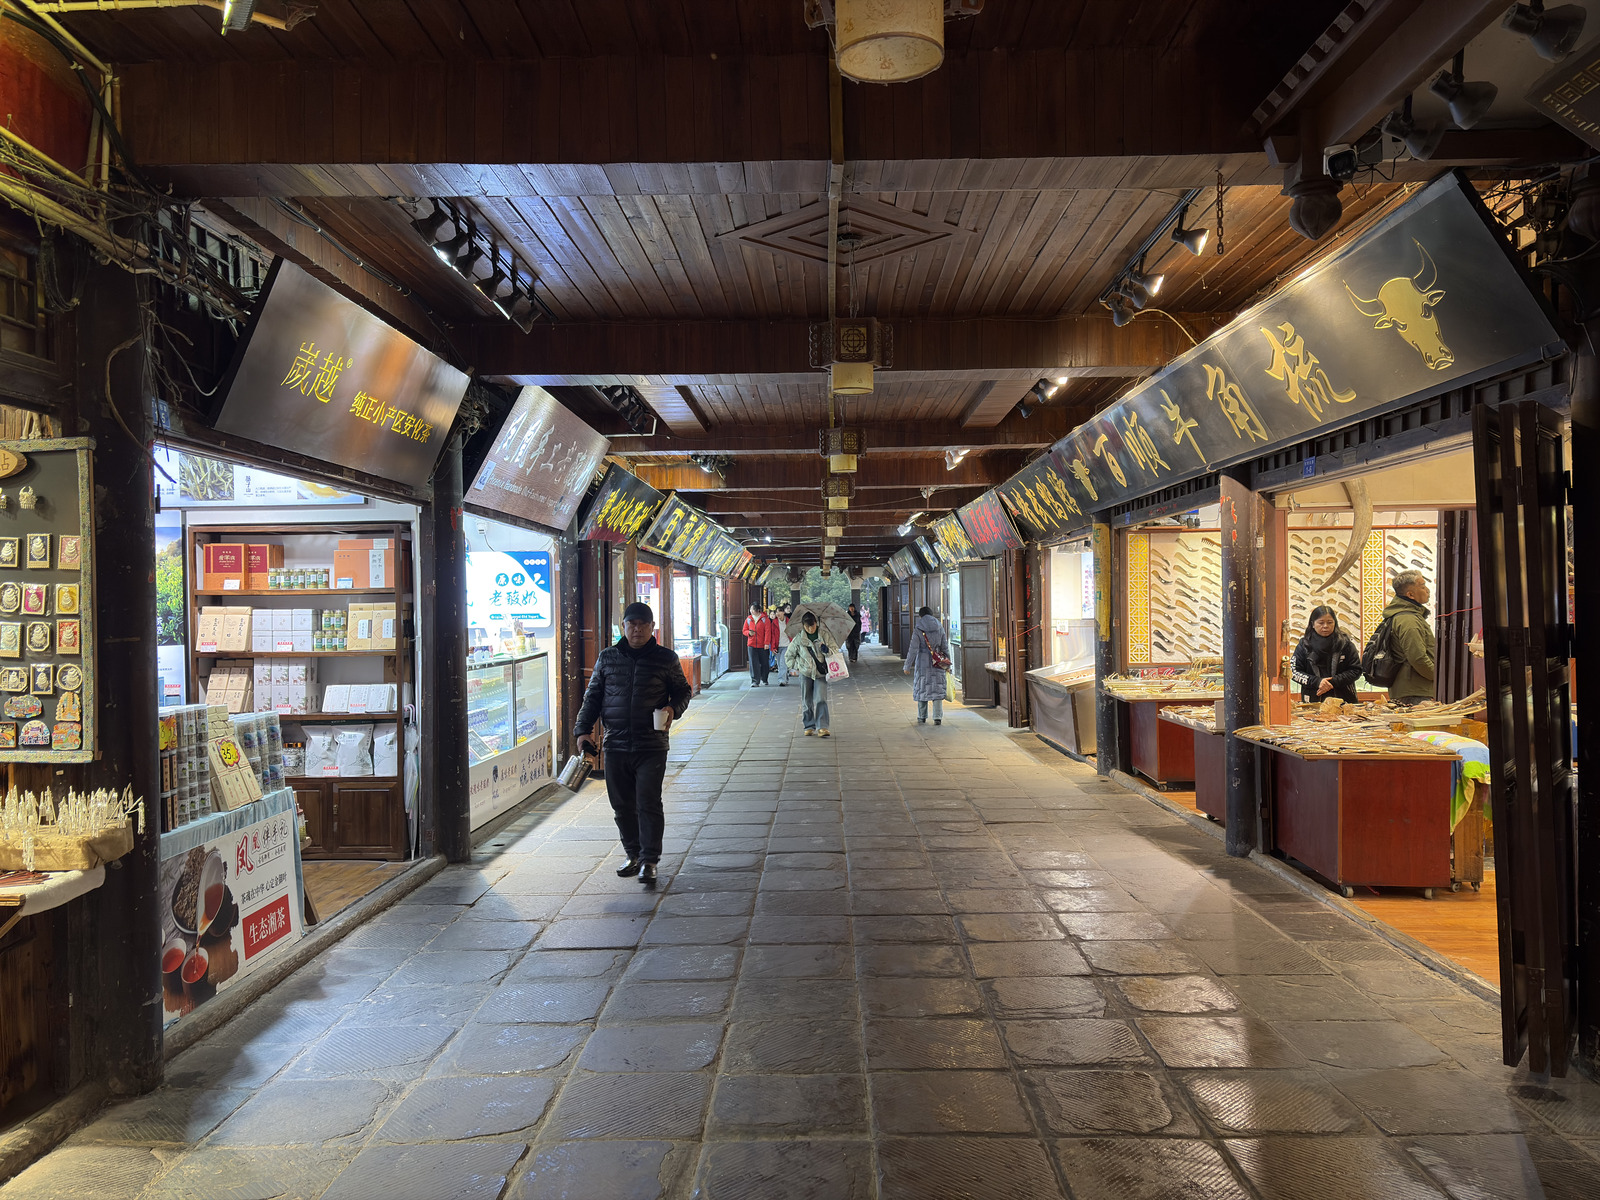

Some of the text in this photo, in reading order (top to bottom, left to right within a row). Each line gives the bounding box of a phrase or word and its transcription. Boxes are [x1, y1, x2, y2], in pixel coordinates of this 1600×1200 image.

[349, 390, 433, 443] 纯正小产区安化茶
[1093, 322, 1357, 488] 百顺牛角梳
[597, 488, 654, 537] 酸奶冰淇淋
[489, 589, 538, 607] 老酸奶
[497, 573, 524, 585] 原味
[249, 906, 286, 945] 生态湘茶
